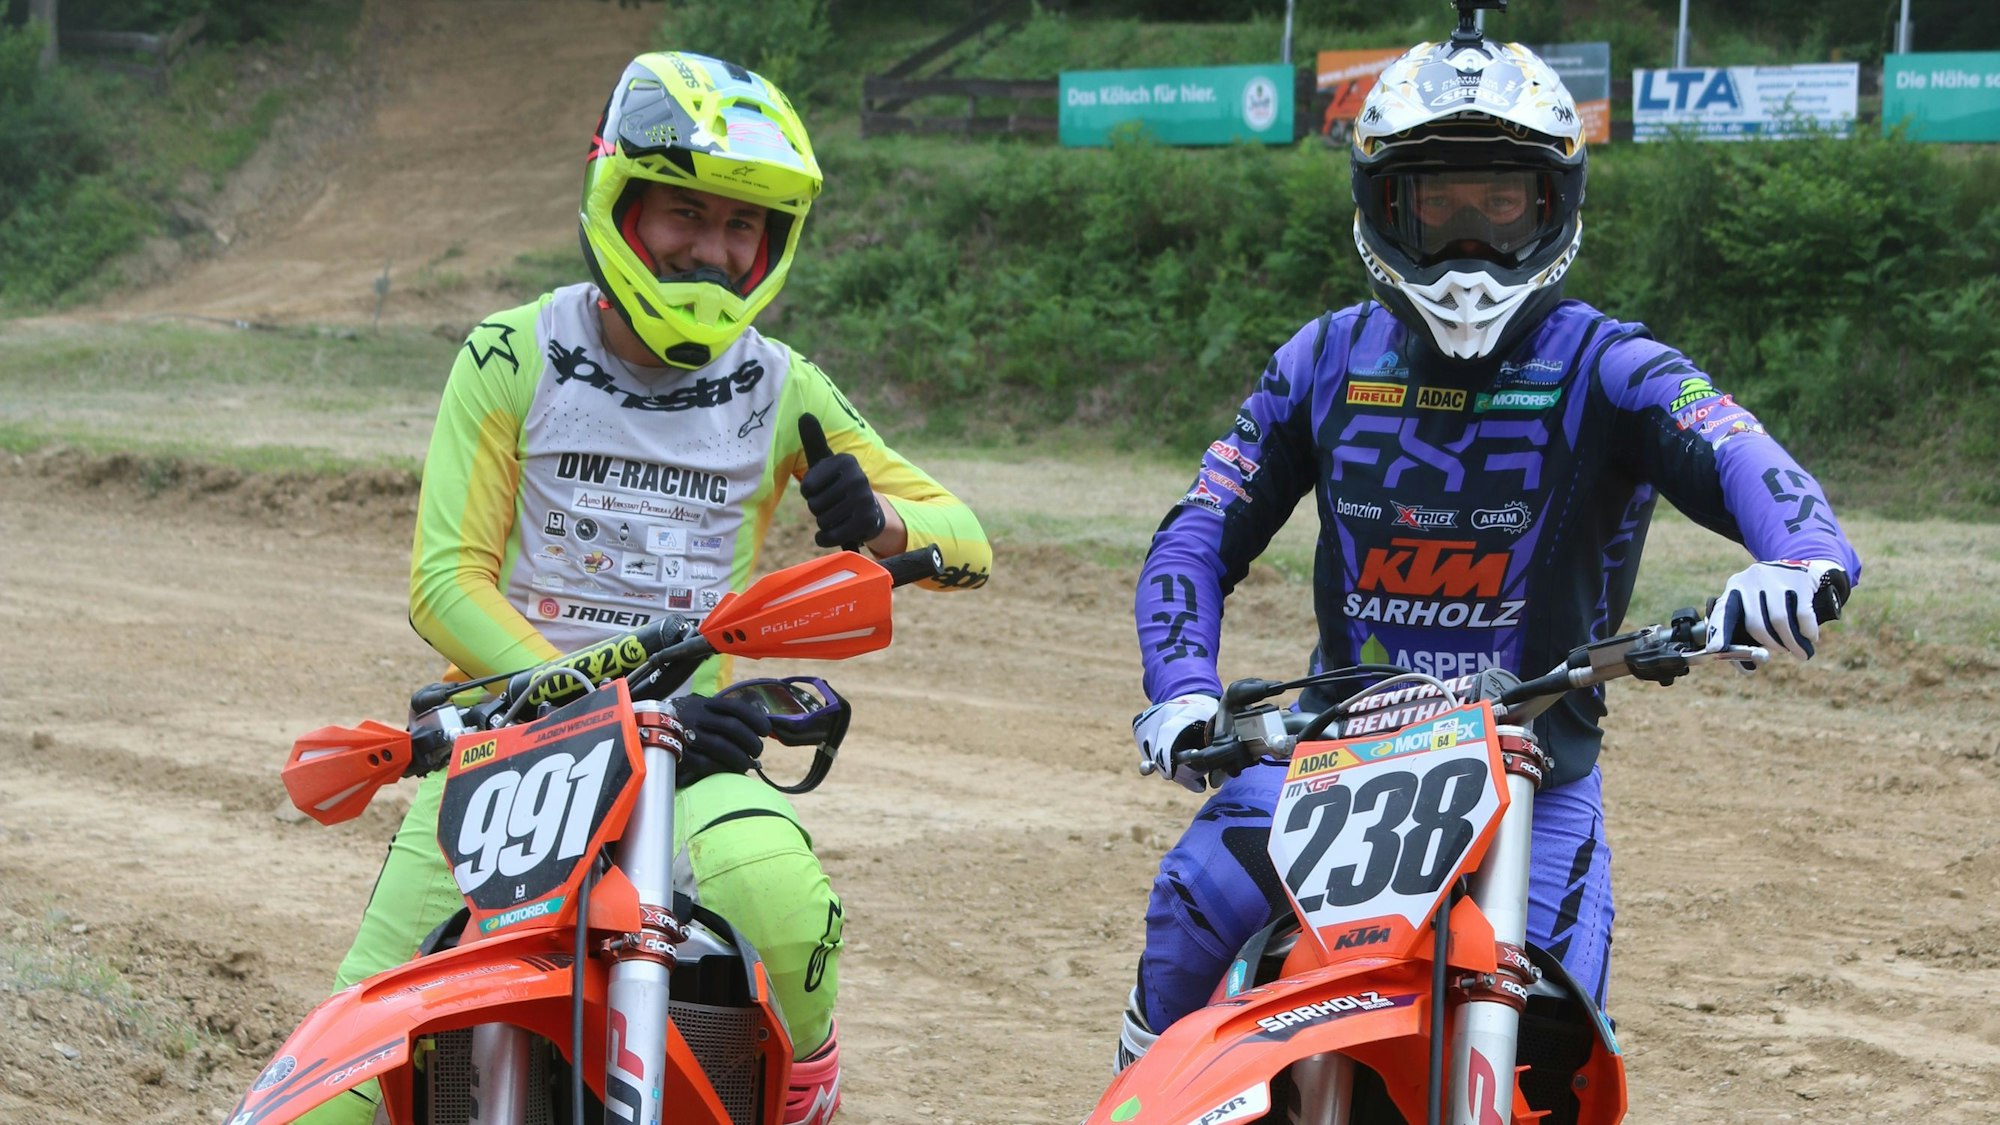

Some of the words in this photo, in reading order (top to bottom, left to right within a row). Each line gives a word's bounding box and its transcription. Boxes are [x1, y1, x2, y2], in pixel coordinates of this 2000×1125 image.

[1638, 71, 1738, 110] LTA
[1896, 70, 1927, 89] Die
[1931, 69, 1980, 89] Nähe
[1067, 87, 1096, 106] Das
[1100, 84, 1150, 105] Kölsch
[1153, 83, 1178, 103] für
[1181, 83, 1216, 103] hier.
[1347, 384, 1405, 405] PIRELLI
[1419, 389, 1465, 409] ADAC
[1492, 391, 1558, 407] MOTOREX
[1331, 414, 1549, 492] FXR
[556, 453, 729, 503] DW-RACING
[1399, 506, 1452, 528] XTRIG
[1480, 513, 1517, 524] AFAM
[1357, 538, 1510, 597] KTM
[562, 604, 650, 628] JADEN
[761, 600, 857, 635] POLISRT
[1343, 593, 1527, 628] SARHOLZ
[1394, 650, 1500, 680] ASPEN
[1348, 675, 1473, 713] RENTHAL
[1394, 721, 1477, 754] MOTEX
[1437, 734, 1449, 748] 64
[462, 741, 496, 767] ADAC
[1299, 752, 1338, 775] ADAC
[454, 738, 615, 894] 991
[1284, 757, 1488, 913] 238
[499, 901, 551, 927] MOTOREX
[1333, 926, 1391, 951] KTM
[1256, 991, 1389, 1033] SARHOLZ
[1362, 1001, 1395, 1011] RACING
[1200, 1096, 1247, 1125] FXR
